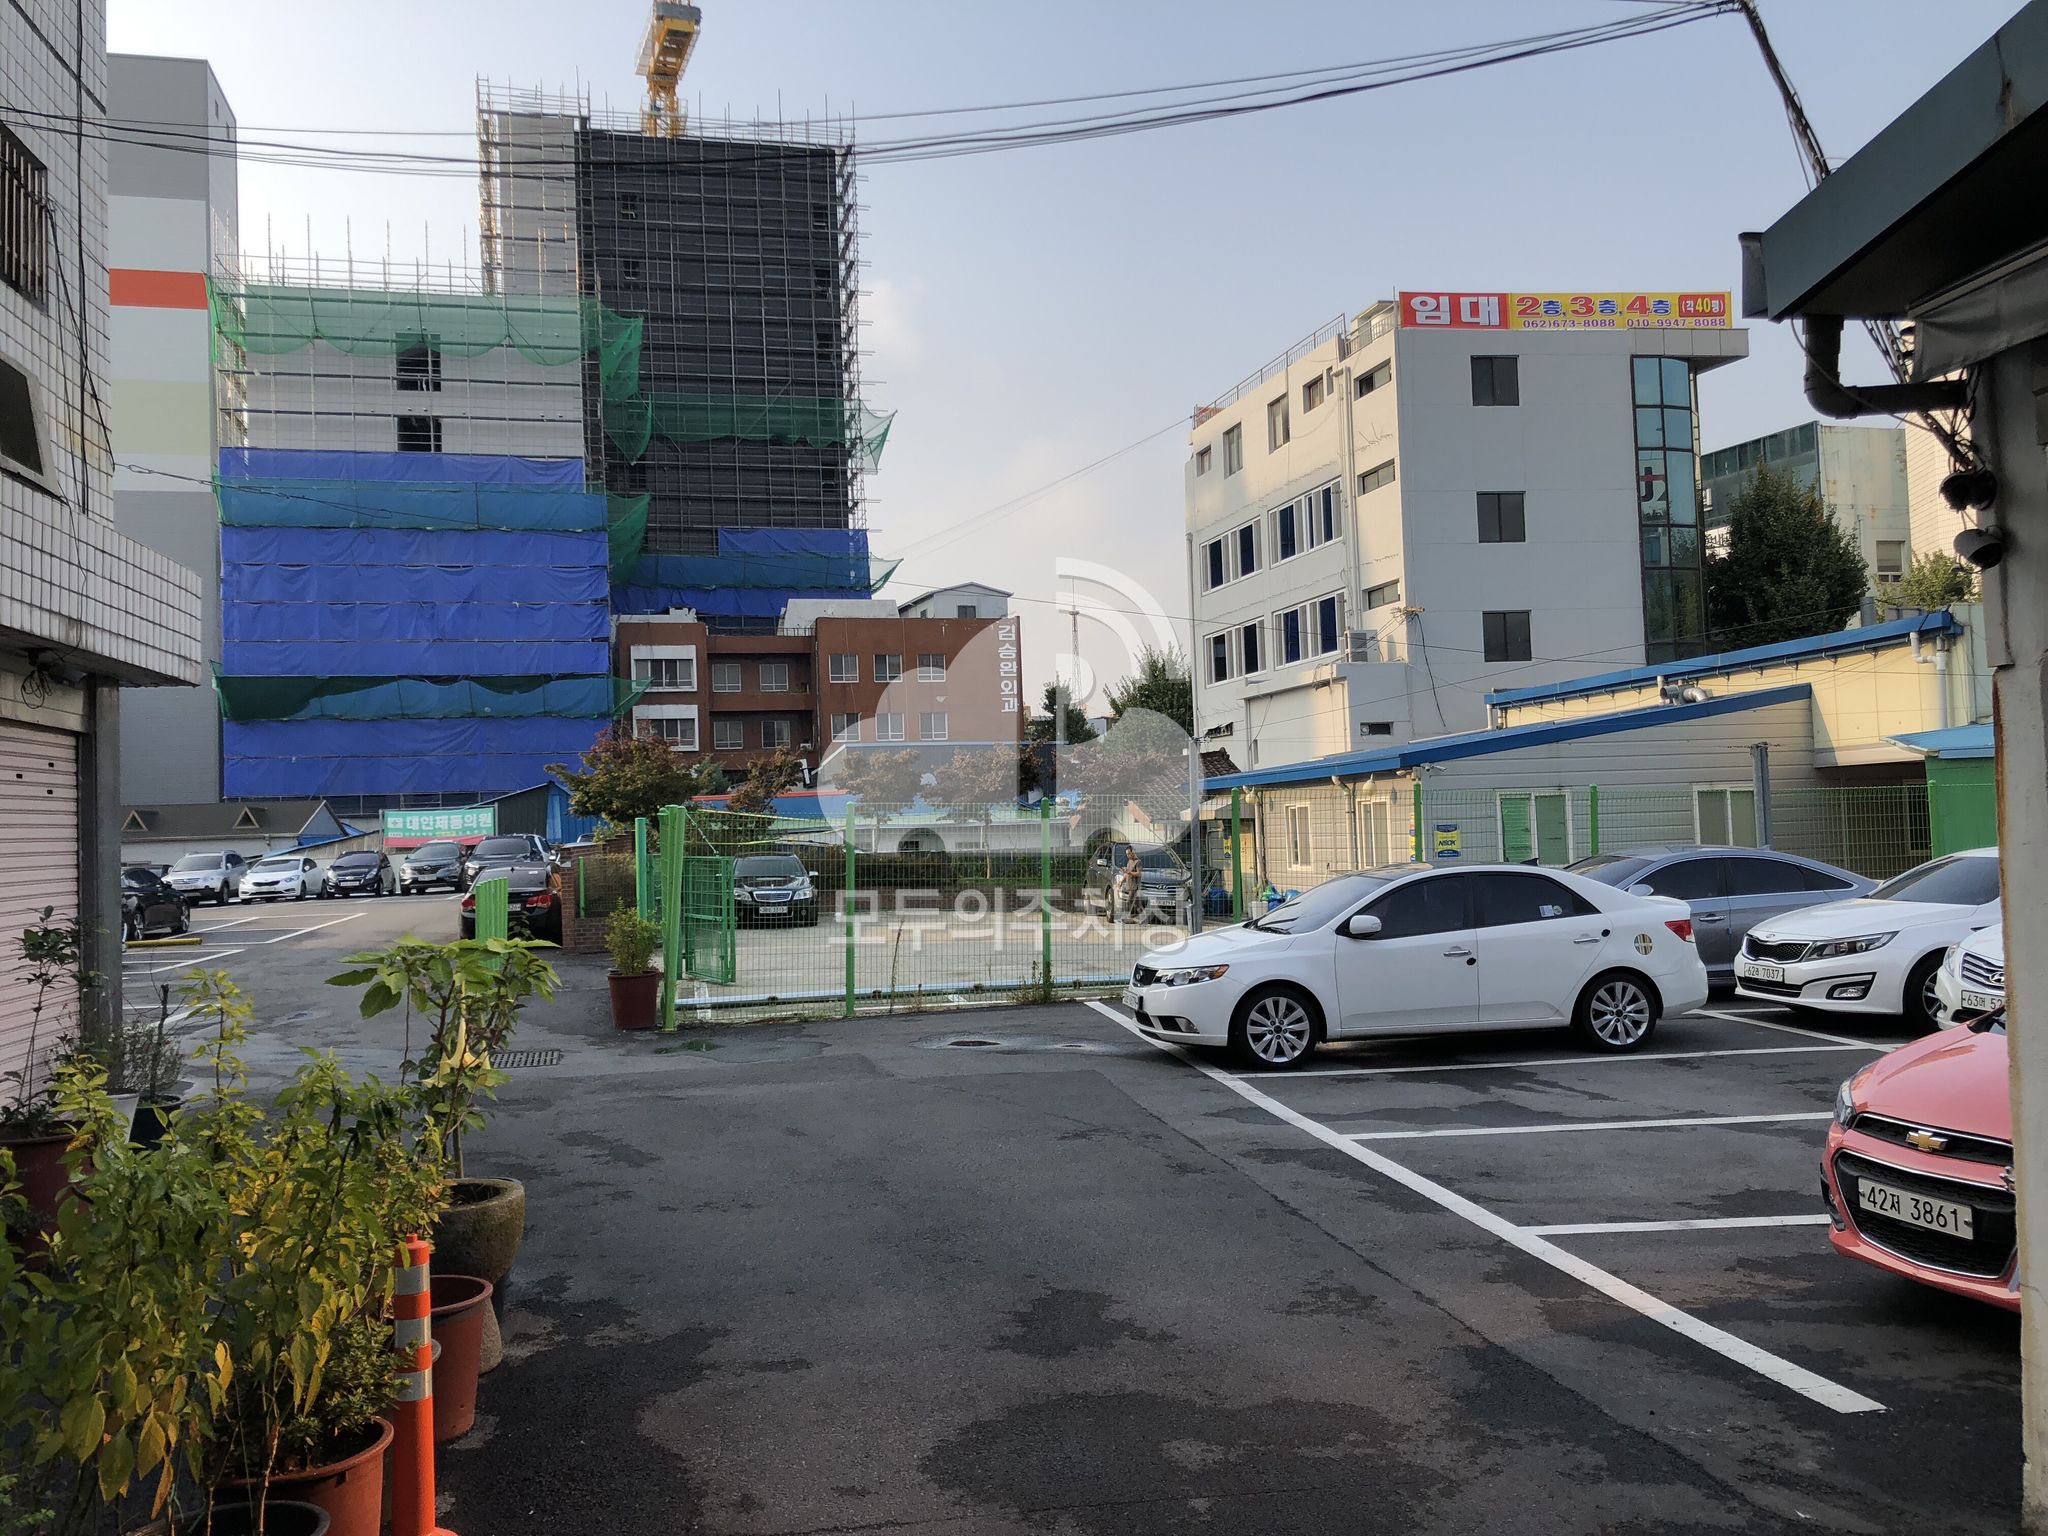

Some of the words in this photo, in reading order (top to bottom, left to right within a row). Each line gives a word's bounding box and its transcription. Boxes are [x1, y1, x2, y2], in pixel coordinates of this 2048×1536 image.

[1410, 296, 1500, 326] 임대
[1522, 318, 1616, 328] 062)673-8088
[1626, 318, 1726, 328] 010-9947-8088
[998, 623, 1018, 713] 김승완외과
[1762, 967, 1780, 980] 7037
[1867, 1186, 1901, 1214] 42저
[1909, 1197, 1959, 1232] 3861
